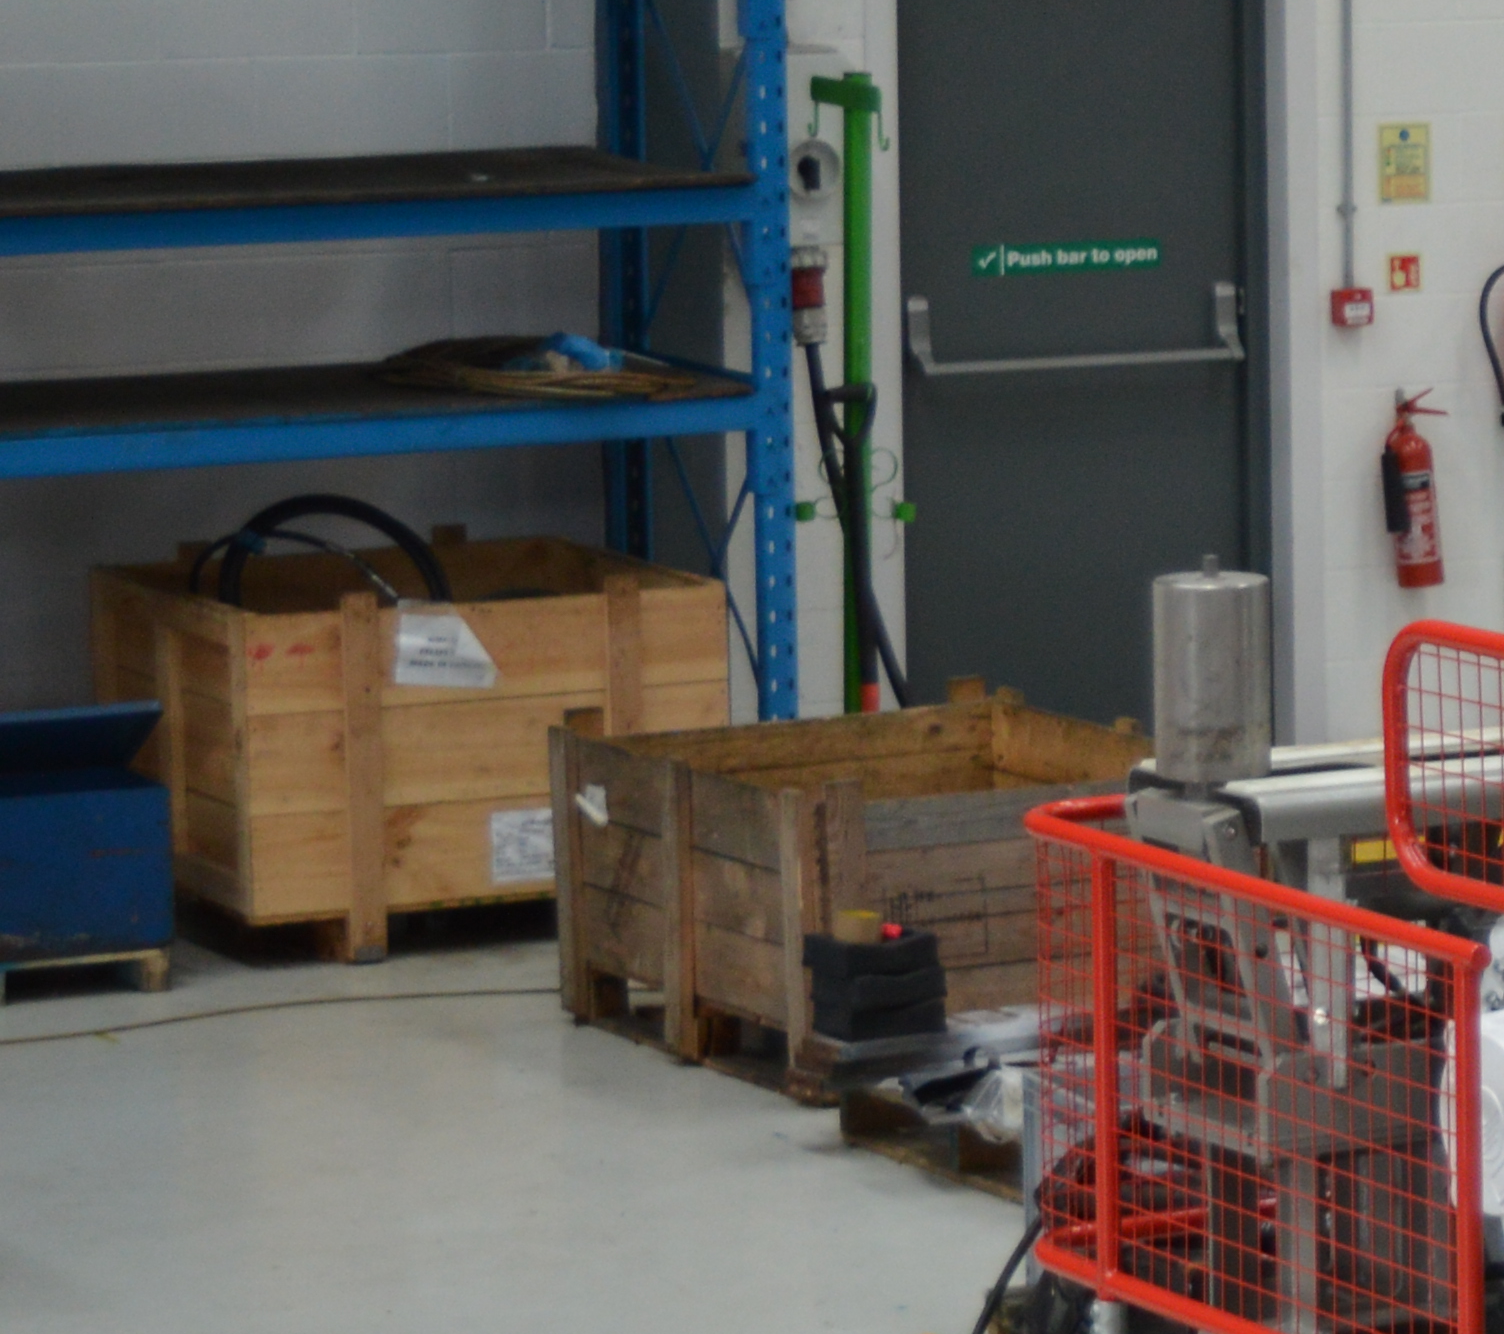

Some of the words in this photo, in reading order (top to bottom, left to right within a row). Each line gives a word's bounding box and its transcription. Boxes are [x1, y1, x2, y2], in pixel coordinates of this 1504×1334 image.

[1007, 250, 1053, 267] Push
[1057, 249, 1087, 265] bar
[1091, 248, 1110, 263] to
[1114, 247, 1158, 265] open
